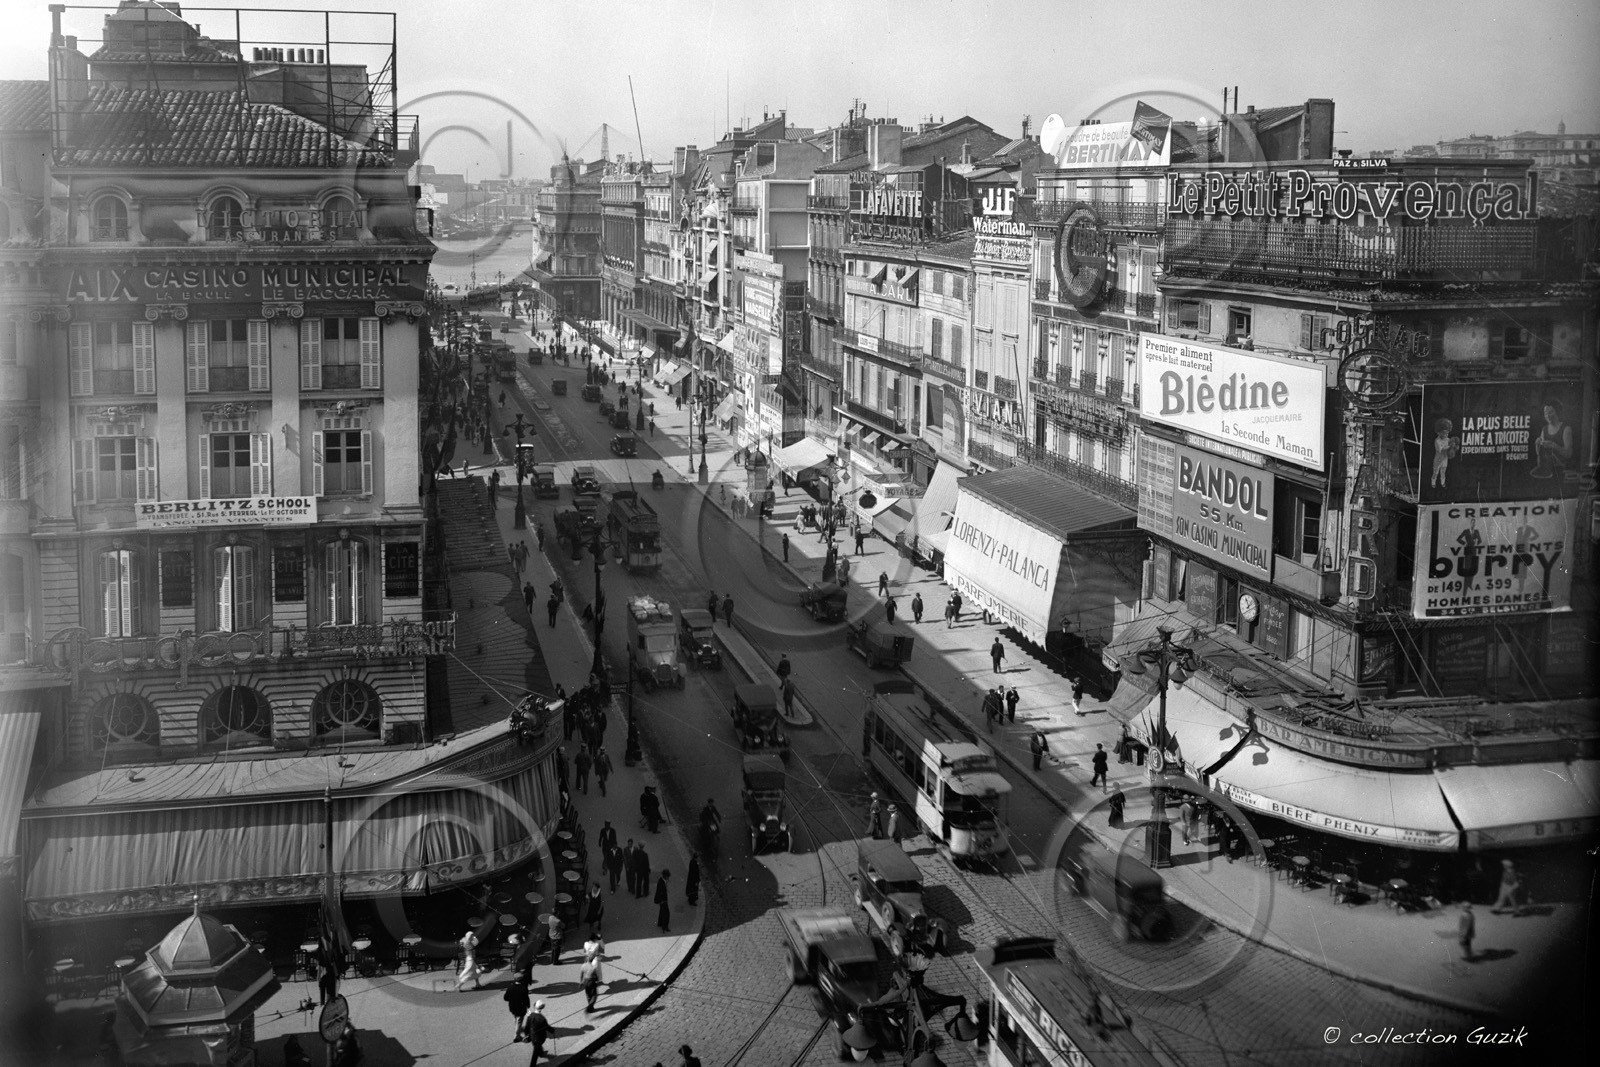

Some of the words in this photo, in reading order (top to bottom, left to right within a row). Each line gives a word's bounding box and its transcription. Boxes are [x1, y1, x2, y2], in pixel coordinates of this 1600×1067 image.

[1091, 129, 1101, 141] de
[1067, 139, 1155, 163] BERTIMAY
[1333, 160, 1351, 168] PAZ
[1361, 159, 1387, 167] SILVA
[861, 190, 922, 218] LAFAYETTE
[1167, 172, 1198, 214] Le
[1204, 171, 1278, 216] Petit
[1286, 169, 1540, 228] Provençal
[196, 210, 361, 228] VICTORIA
[972, 216, 1026, 235] Waterman
[225, 231, 337, 242] ASSURANCES
[67, 268, 138, 301] AIX
[144, 269, 248, 288] CASINO
[261, 266, 410, 287] MUNICIPAL
[155, 290, 173, 300] LA
[182, 290, 232, 299] BOULE
[262, 288, 284, 300] LE
[293, 287, 390, 300] BACCARA
[1320, 312, 1430, 357] COGNAC
[1145, 339, 1178, 353] Premier
[1180, 345, 1213, 362] aliment
[1145, 352, 1161, 363] après
[1168, 354, 1179, 365] lait
[1180, 357, 1213, 373] maternel
[1159, 370, 1290, 416] Blédine
[1251, 413, 1303, 424] JACQUEMAIRE
[1462, 417, 1475, 430] LA
[1477, 416, 1501, 431] PLUS
[1503, 415, 1531, 429] BELLE
[1221, 420, 1230, 433] la
[1232, 423, 1271, 445] Seconde
[1275, 434, 1314, 458] Maman
[1461, 432, 1485, 446] LAINE
[1486, 432, 1493, 445] A
[1494, 431, 1530, 445] TRICOTER
[1461, 446, 1496, 454] EXPEDITIONS
[1496, 445, 1510, 453] DANS
[1511, 444, 1529, 452] TOUTES
[1178, 455, 1268, 521] BANDOL
[142, 500, 252, 514] BERLITZ
[258, 498, 311, 510] SCHOOL
[276, 508, 308, 516] OCTOBRE
[1448, 504, 1560, 518] CREATION
[153, 519, 218, 528] LANGUES
[1175, 516, 1189, 539] SON
[1191, 522, 1218, 551] CASINO
[1220, 533, 1268, 572] MUNICIPAL
[1450, 541, 1564, 556] VETEMENTS
[1429, 511, 1562, 600] burry
[1427, 585, 1439, 593] DE
[1442, 581, 1462, 592] 149
[1486, 578, 1512, 590] 399
[957, 576, 1029, 632] PARFUMERIE
[1428, 595, 1490, 607] HOMMES
[1495, 592, 1540, 604] DAMES
[1260, 719, 1292, 742] BAR
[1299, 737, 1417, 764] AMERICAIN
[1271, 802, 1313, 822] BIERE
[1324, 818, 1380, 836] PHENIX
